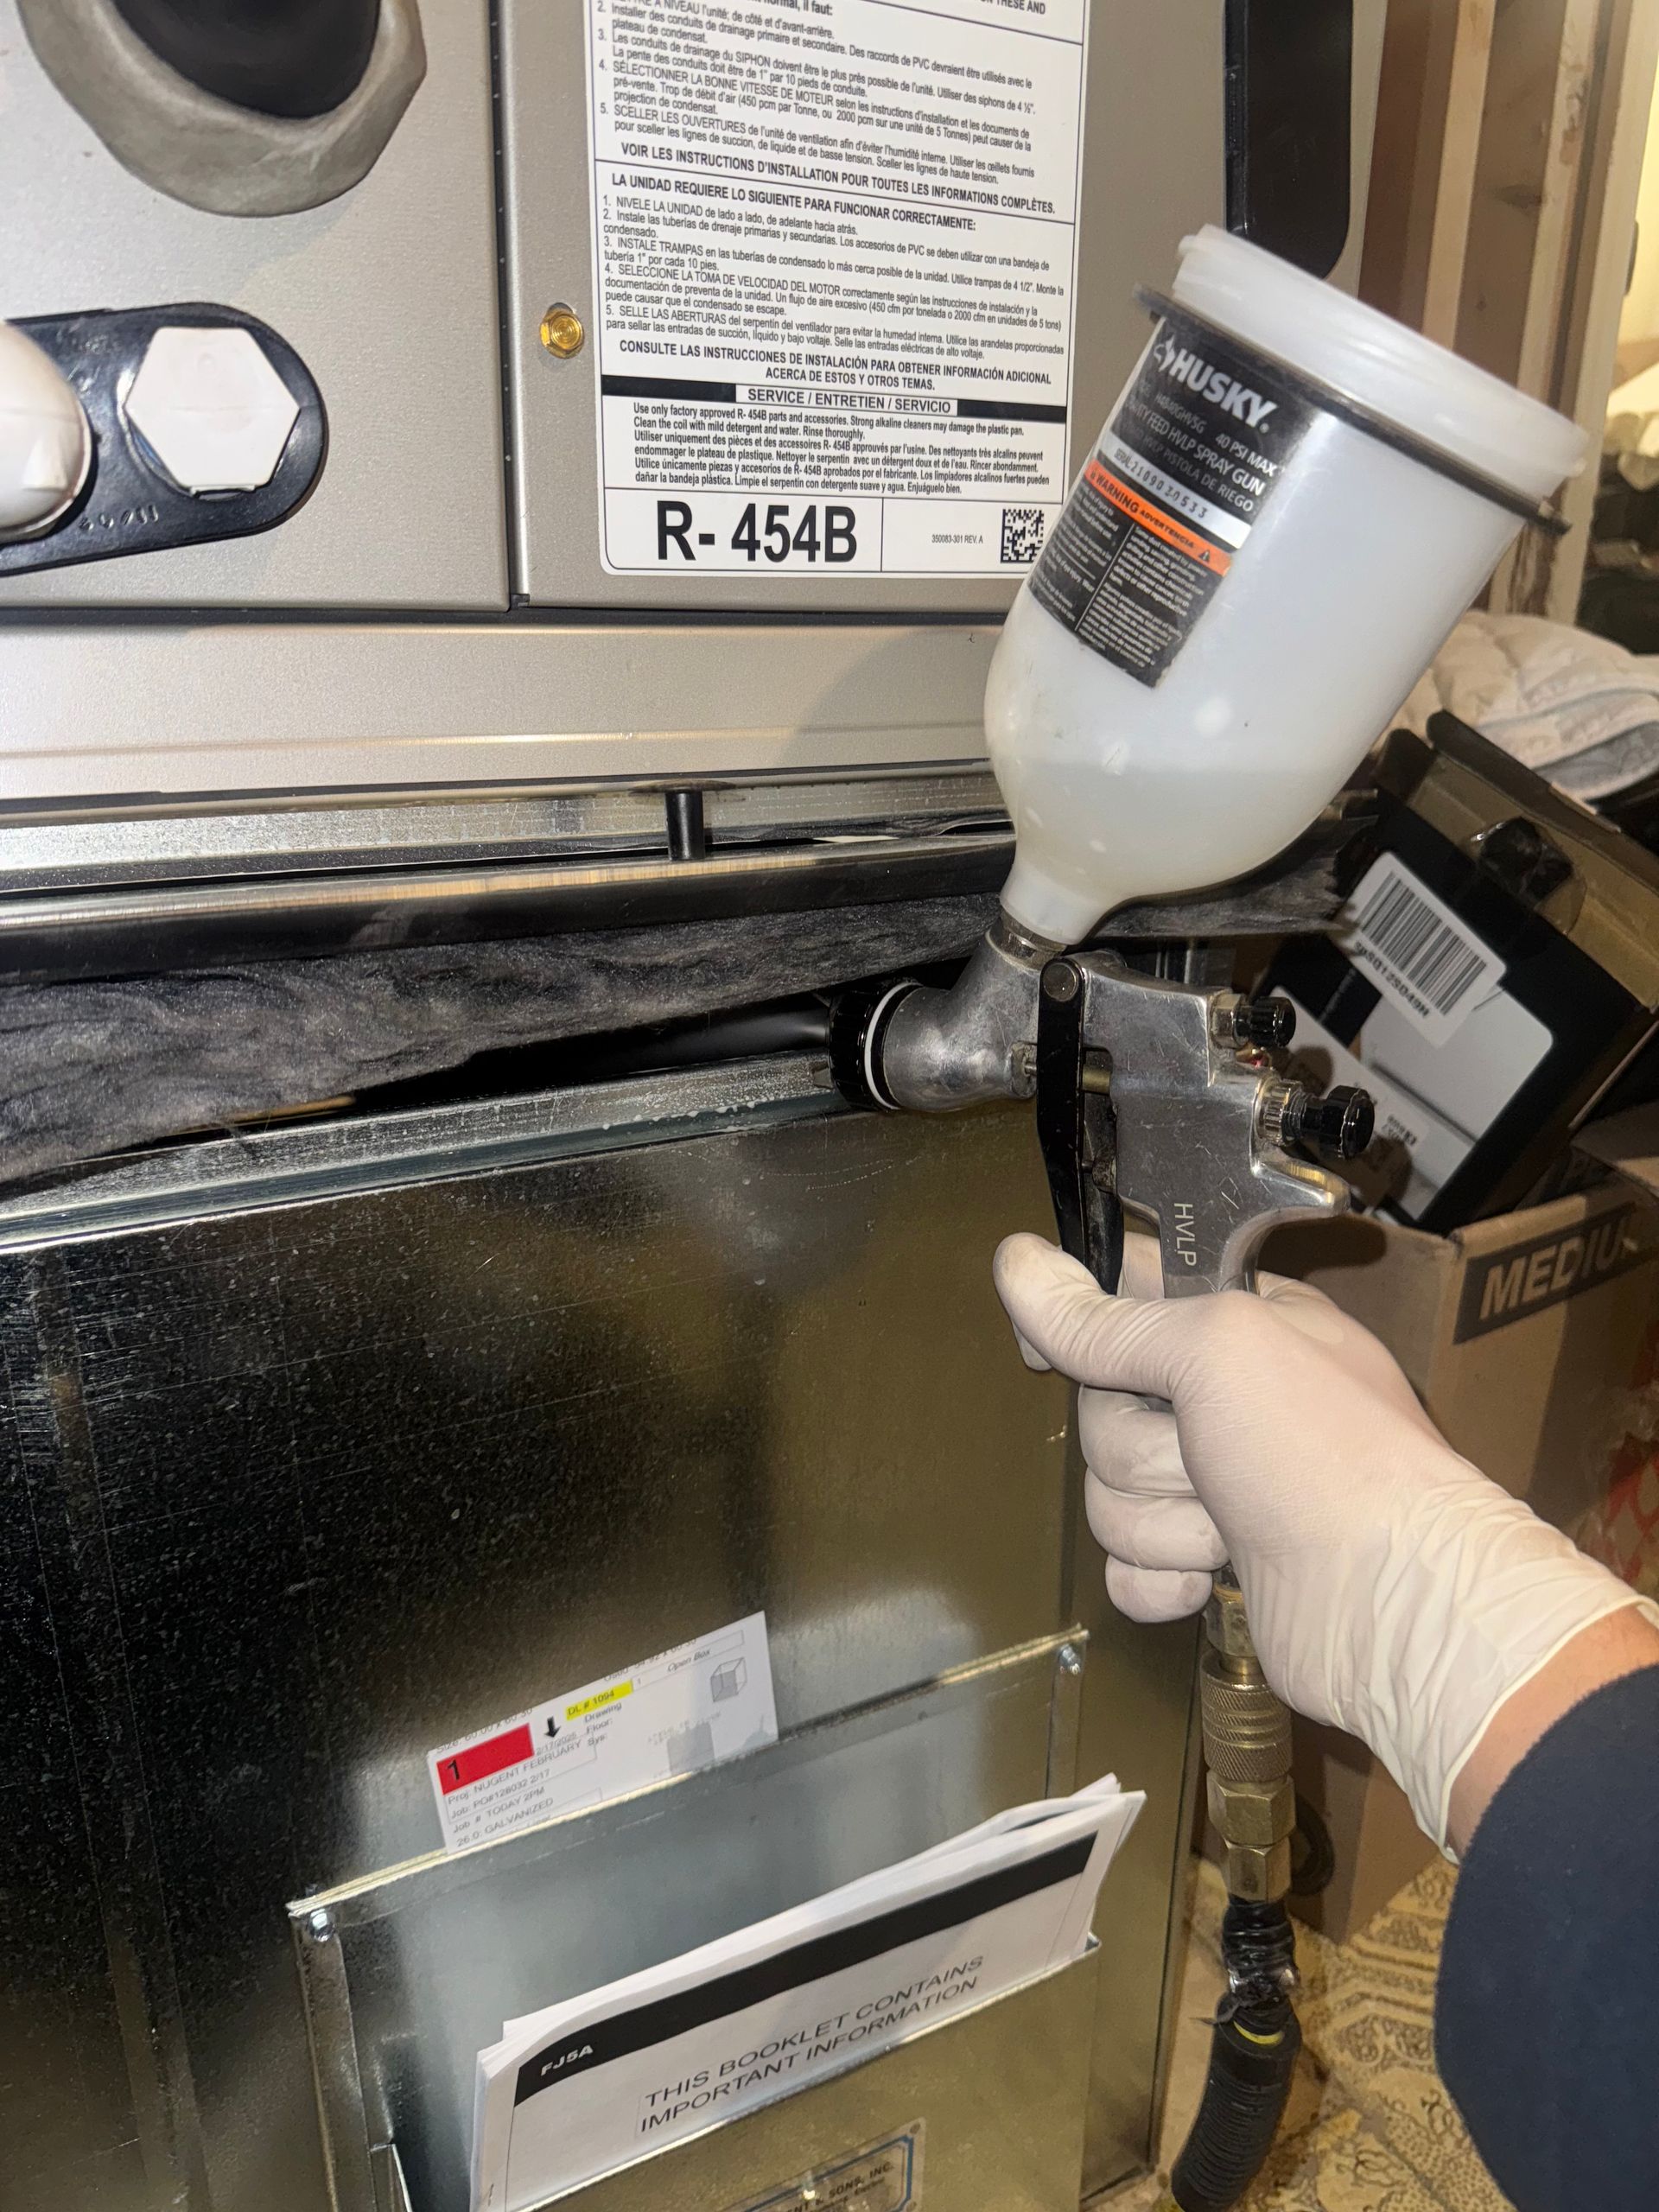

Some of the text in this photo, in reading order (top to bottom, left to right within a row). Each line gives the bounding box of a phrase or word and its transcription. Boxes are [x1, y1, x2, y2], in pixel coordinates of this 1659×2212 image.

[811, 1, 833, 16] faut:
[1027, 1, 1046, 15] AND
[621, 143, 1056, 214] VOIR LES INSTRUCTIONS D'INSTALLATION POUR TOUTES LES INFORMATIONS COMPLÈTES.
[612, 173, 976, 231] LA UNIDAD REQUIERE LO SIGUIENTE PARA FUNCIONAR CORRECTAMENTE:
[619, 340, 1052, 385] CONSULTE LAS INSTRUCCIONES DE INSTALACIÓN PARA OBTENER INFORMACIÓN ADICIONAL
[765, 365, 936, 392] ACERCA DE ESTOS Y OTROS TEMAS.
[747, 388, 805, 404] SERVICE
[815, 392, 885, 410] ENTRETIEN
[894, 397, 951, 413] SERVICIO
[1169, 348, 1278, 428] HUSKY
[633, 402, 650, 414] Use
[651, 404, 669, 419] only
[670, 404, 698, 421] factory
[699, 408, 736, 422] approved
[747, 409, 767, 421] 454B
[768, 410, 788, 425] parts
[788, 411, 803, 423] and
[804, 414, 849, 426] accessories.
[849, 415, 874, 430] Strong
[874, 416, 902, 429] alkaline
[903, 417, 932, 430] cleaners
[932, 422, 948, 435] may
[948, 420, 975, 435] damage
[976, 422, 987, 434] the
[987, 423, 1009, 437] plastic
[1010, 426, 1025, 438] pan.
[633, 416, 866, 443] Clean the coil with mild detergent and water. Rinse thoroughly.
[1147, 412, 1170, 435] FEED
[1168, 429, 1197, 451] HVLP
[1193, 445, 1234, 475] SPRAY
[1232, 467, 1266, 496] GUN
[1215, 434, 1230, 448] 40
[1230, 442, 1249, 458] PSI
[1247, 452, 1278, 477] MAX
[1096, 472, 1140, 513] WARNING
[1164, 449, 1200, 479] PISTOLA
[1200, 474, 1217, 491] DE
[1218, 484, 1254, 512] RIEGO
[731, 503, 857, 563] 454B
[1174, 1203, 1197, 1266] HVLP
[1479, 1216, 1629, 1321] MEDIU
[668, 1657, 691, 1672] Open
[692, 1649, 711, 1661] Box
[567, 1691, 615, 1716] DL # 1094
[584, 1702, 622, 1723] Drawing
[447, 1759, 460, 1780] 1
[474, 1769, 520, 1792] NUGENT
[524, 1740, 582, 1771] FEBRUARY
[531, 1769, 550, 1783] 2/17
[454, 1821, 471, 1834] Job
[487, 1796, 524, 1816] TODAY
[524, 1786, 545, 1802] 2PM
[485, 1797, 554, 1834] GALVANIZED
[645, 1955, 983, 2107] THIS BOOKLET CONTAINS
[541, 2044, 594, 2076] FJ5A
[640, 1976, 977, 2133] IMPORTANT INFORMATION
